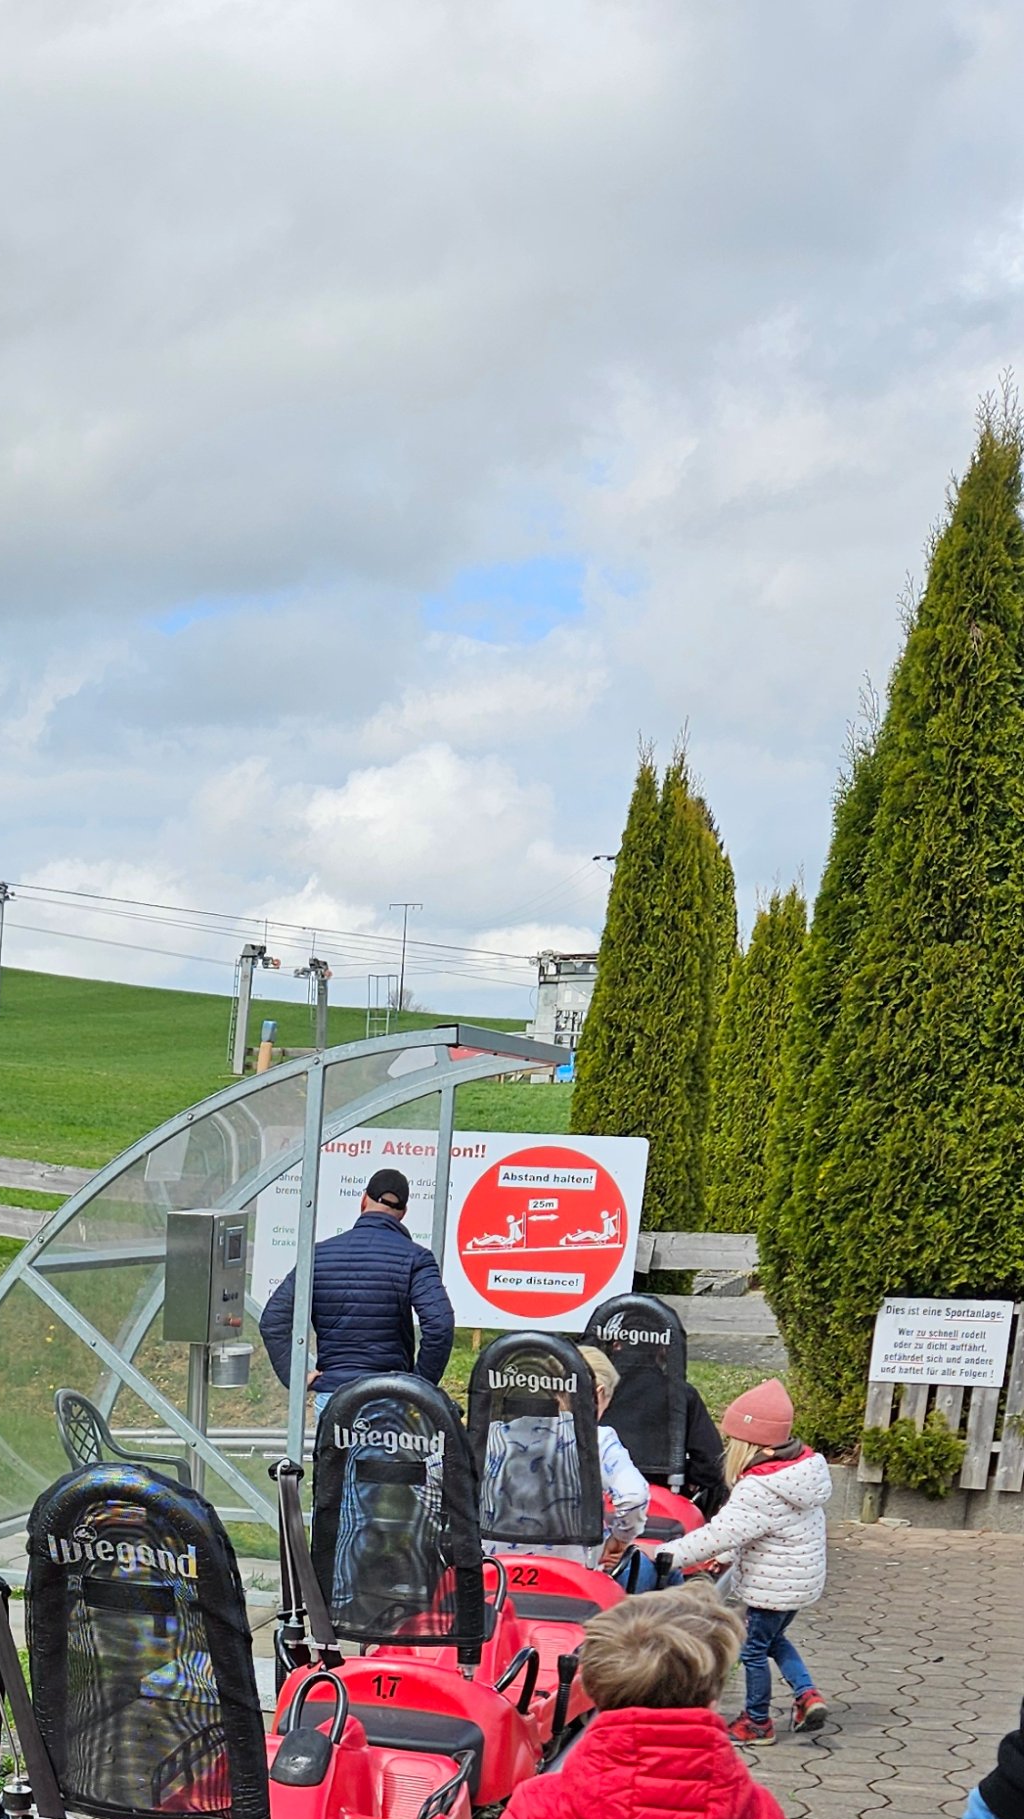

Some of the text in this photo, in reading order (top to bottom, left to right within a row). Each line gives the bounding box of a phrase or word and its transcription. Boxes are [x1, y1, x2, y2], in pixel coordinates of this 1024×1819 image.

[382, 1141, 486, 1158] Attenon!!
[502, 1172, 594, 1184] Abstand halten!
[339, 1187, 366, 1197] Hebe
[533, 1200, 554, 1208] 25m
[273, 1226, 295, 1234] drive
[272, 1239, 296, 1247] brake
[494, 1275, 579, 1287] Keep distance!
[886, 1305, 1005, 1319] Dies ist eine Sportanlage.
[596, 1322, 672, 1346] Wiegand
[898, 1328, 914, 1336] Wer
[916, 1329, 927, 1337] zu
[928, 1329, 959, 1338] schnell
[893, 1341, 911, 1350] oder
[926, 1342, 948, 1351] dicht
[926, 1354, 944, 1363] sich
[946, 1355, 962, 1364] und
[964, 1356, 994, 1366] andere
[880, 1367, 896, 1375] und
[898, 1366, 924, 1376] haftet
[941, 1368, 957, 1377] alle
[959, 1369, 988, 1380] Folgen
[488, 1368, 578, 1394] Wiegand
[334, 1423, 446, 1456] Wiegand
[47, 1533, 199, 1580] Wiegand
